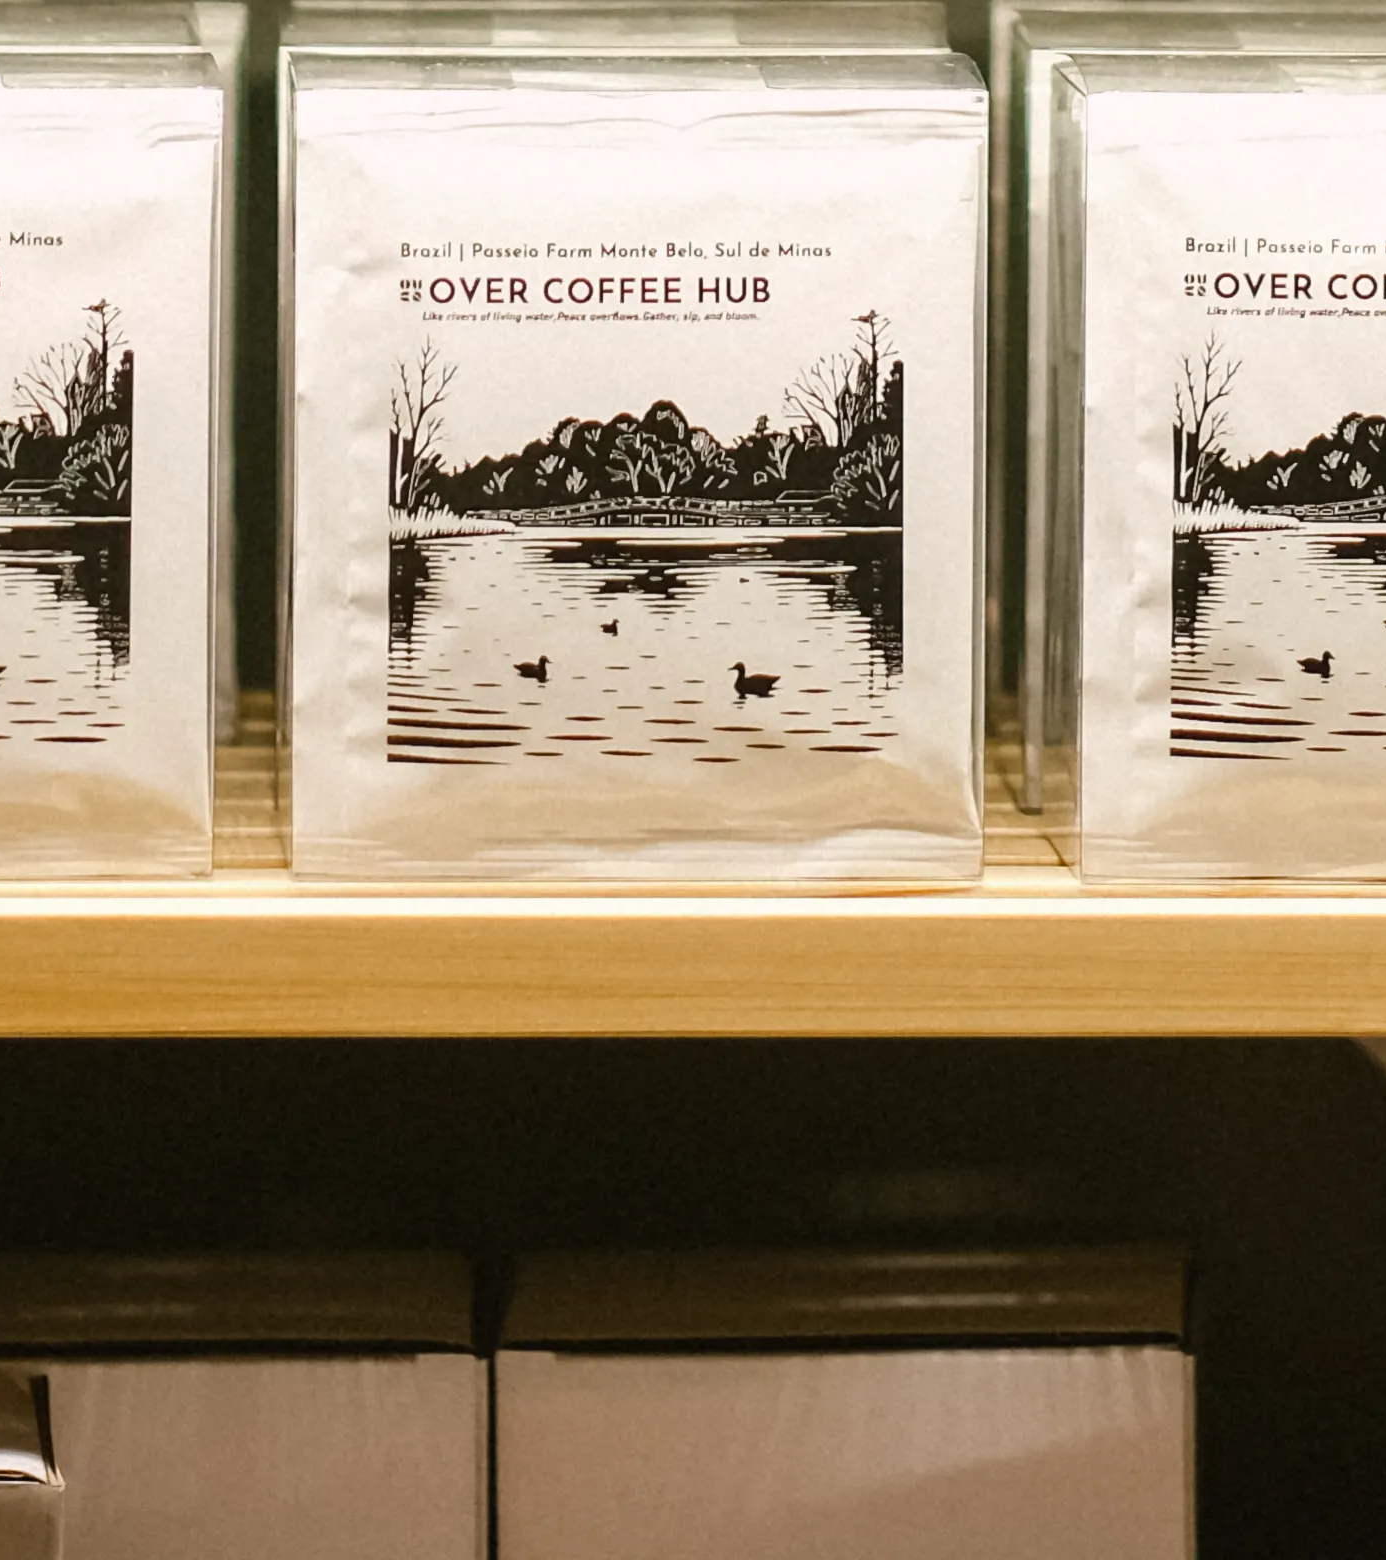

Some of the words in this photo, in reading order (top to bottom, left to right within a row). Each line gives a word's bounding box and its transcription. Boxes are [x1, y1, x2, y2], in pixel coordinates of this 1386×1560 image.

[9, 231, 64, 247] Minas
[1185, 236, 1237, 254] Brazil
[1256, 237, 1324, 254] Passeio
[1331, 238, 1377, 255] Farm
[400, 241, 452, 259] Brazil
[472, 242, 539, 259] Passeio
[546, 242, 593, 259] Farm
[600, 242, 658, 259] Monte
[665, 241, 708, 260] Belo,
[714, 240, 742, 258] Sul
[748, 240, 771, 258] de
[777, 242, 832, 258] Minas
[428, 276, 530, 305] OVER
[542, 276, 683, 305] COFFEE
[697, 276, 771, 304] HUB
[1213, 271, 1314, 301] OVER
[422, 311, 444, 322] Like
[480, 311, 492, 322] of
[703, 311, 724, 321] and
[1206, 305, 1228, 316] Like
[1264, 306, 1276, 317] of
